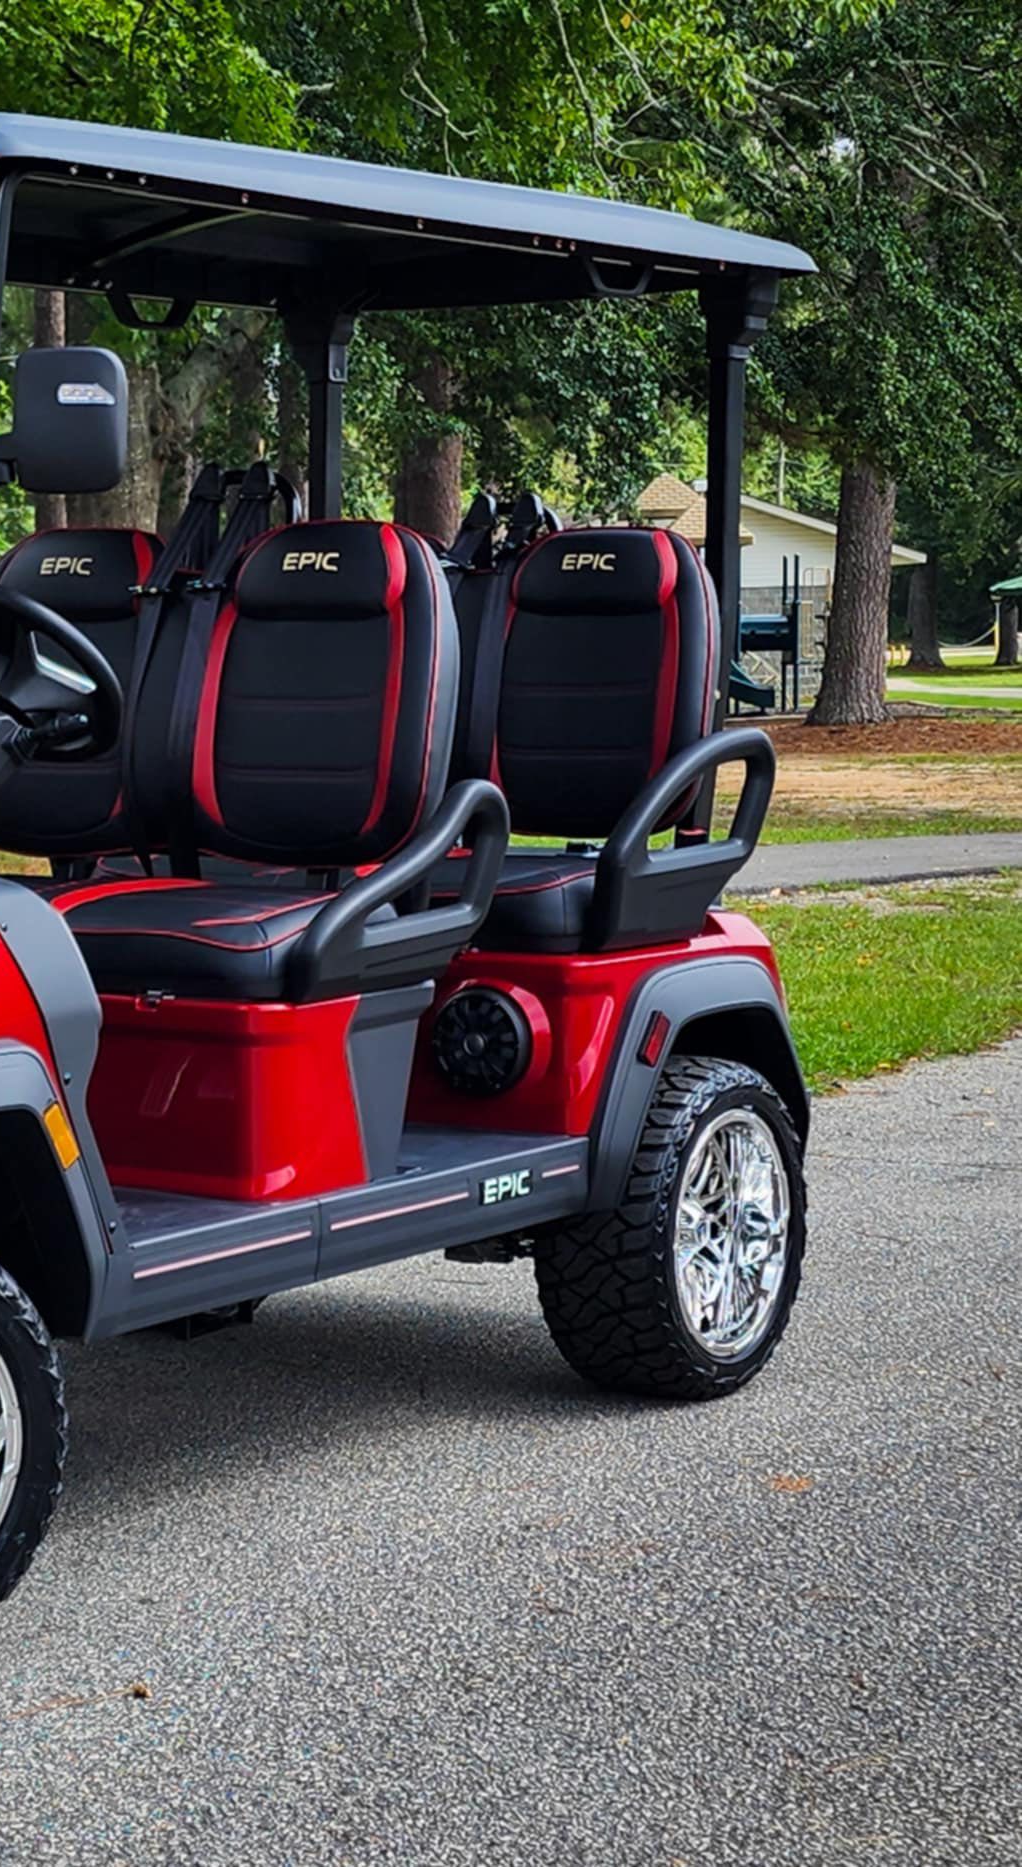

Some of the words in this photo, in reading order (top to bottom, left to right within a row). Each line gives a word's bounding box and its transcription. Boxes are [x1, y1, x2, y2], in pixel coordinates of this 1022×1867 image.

[40, 556, 93, 576] EPIC
[282, 552, 340, 572] EPIC
[561, 553, 616, 571] EPIC
[483, 1168, 531, 1205] EPIC
